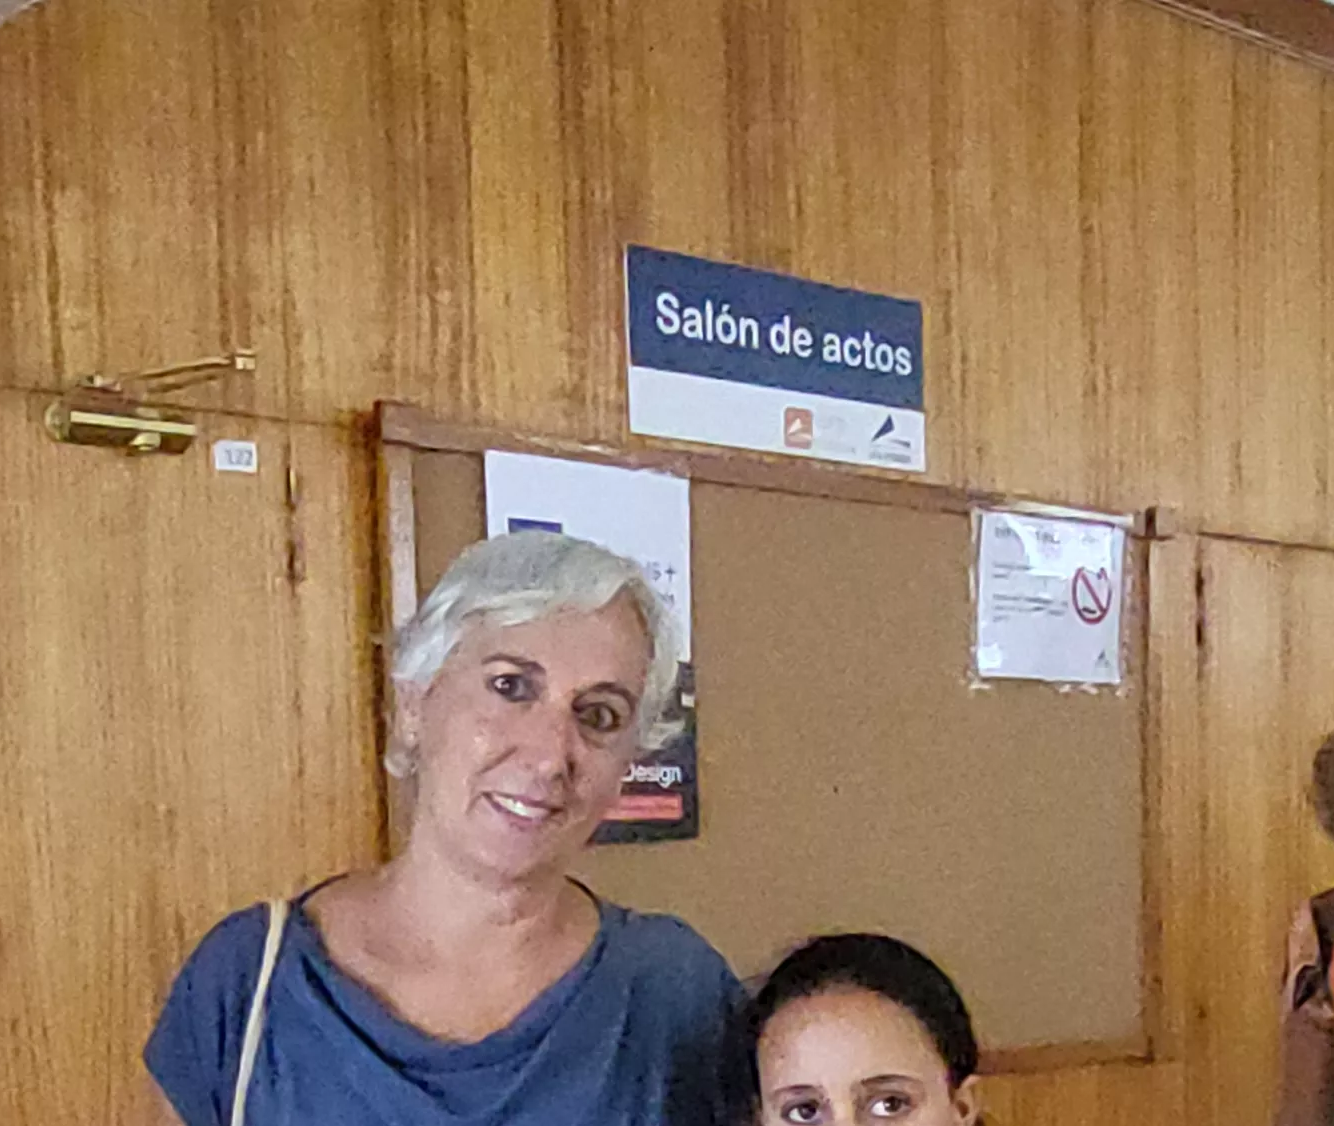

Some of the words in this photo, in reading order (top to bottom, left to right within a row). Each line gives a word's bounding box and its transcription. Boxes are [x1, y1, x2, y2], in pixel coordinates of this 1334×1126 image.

[656, 292, 760, 349] Salón
[770, 315, 813, 358] de
[822, 331, 912, 376] actos
